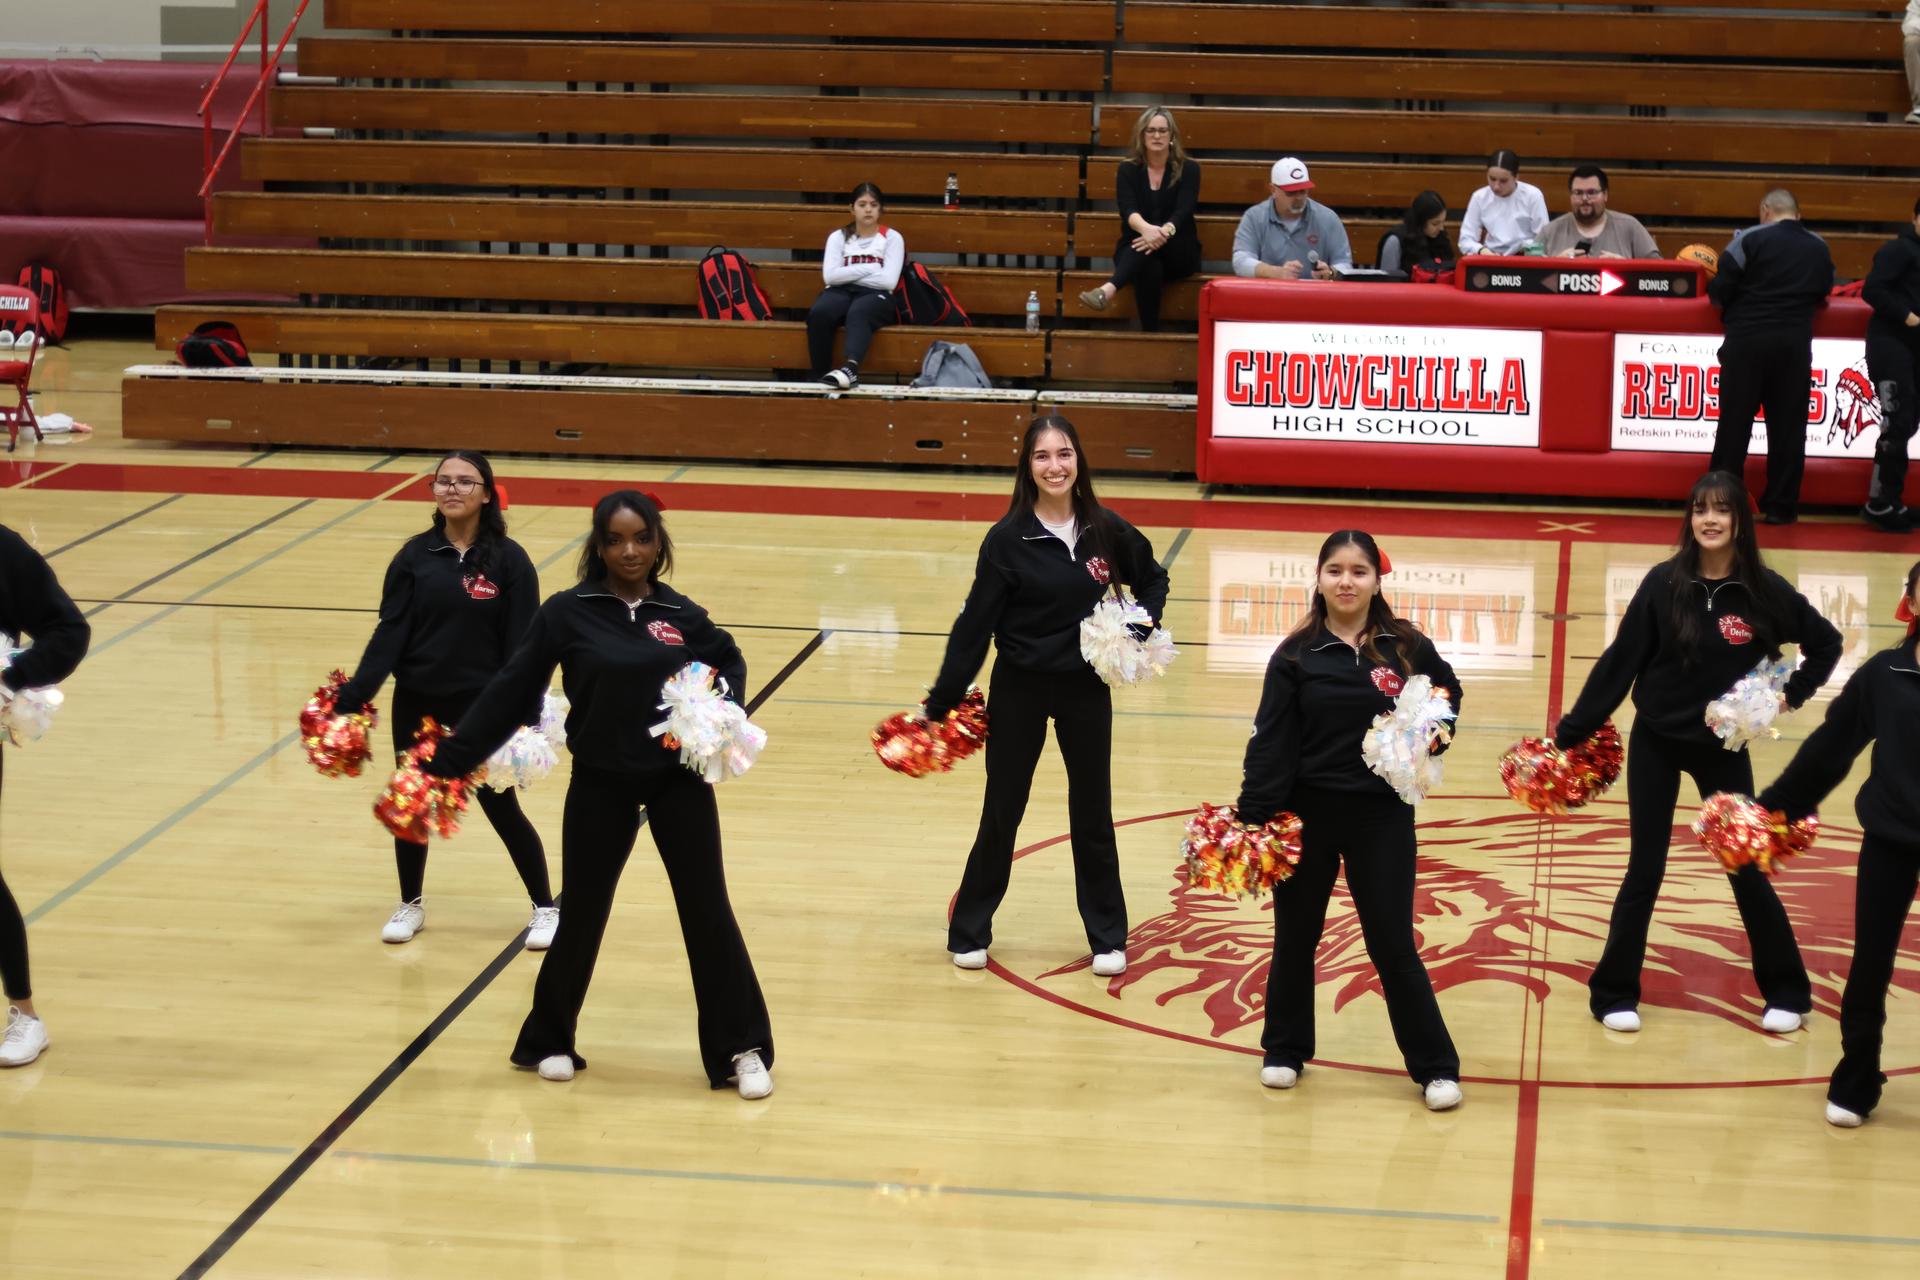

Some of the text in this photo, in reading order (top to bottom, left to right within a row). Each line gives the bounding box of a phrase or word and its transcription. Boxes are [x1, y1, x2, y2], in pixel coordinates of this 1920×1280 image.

[1290, 168, 1304, 180] C
[1491, 275, 1522, 287] BONUS
[1559, 274, 1601, 292] POSS
[1638, 279, 1669, 291] BONUS
[1640, 342, 1678, 354] FCA
[1225, 349, 1530, 415] CHOWCHILLA
[1621, 361, 1828, 425] REDSS
[1273, 415, 1479, 437] HIGH SCHOOL
[1619, 427, 1671, 437] Redskin
[1675, 429, 1708, 439] Pride
